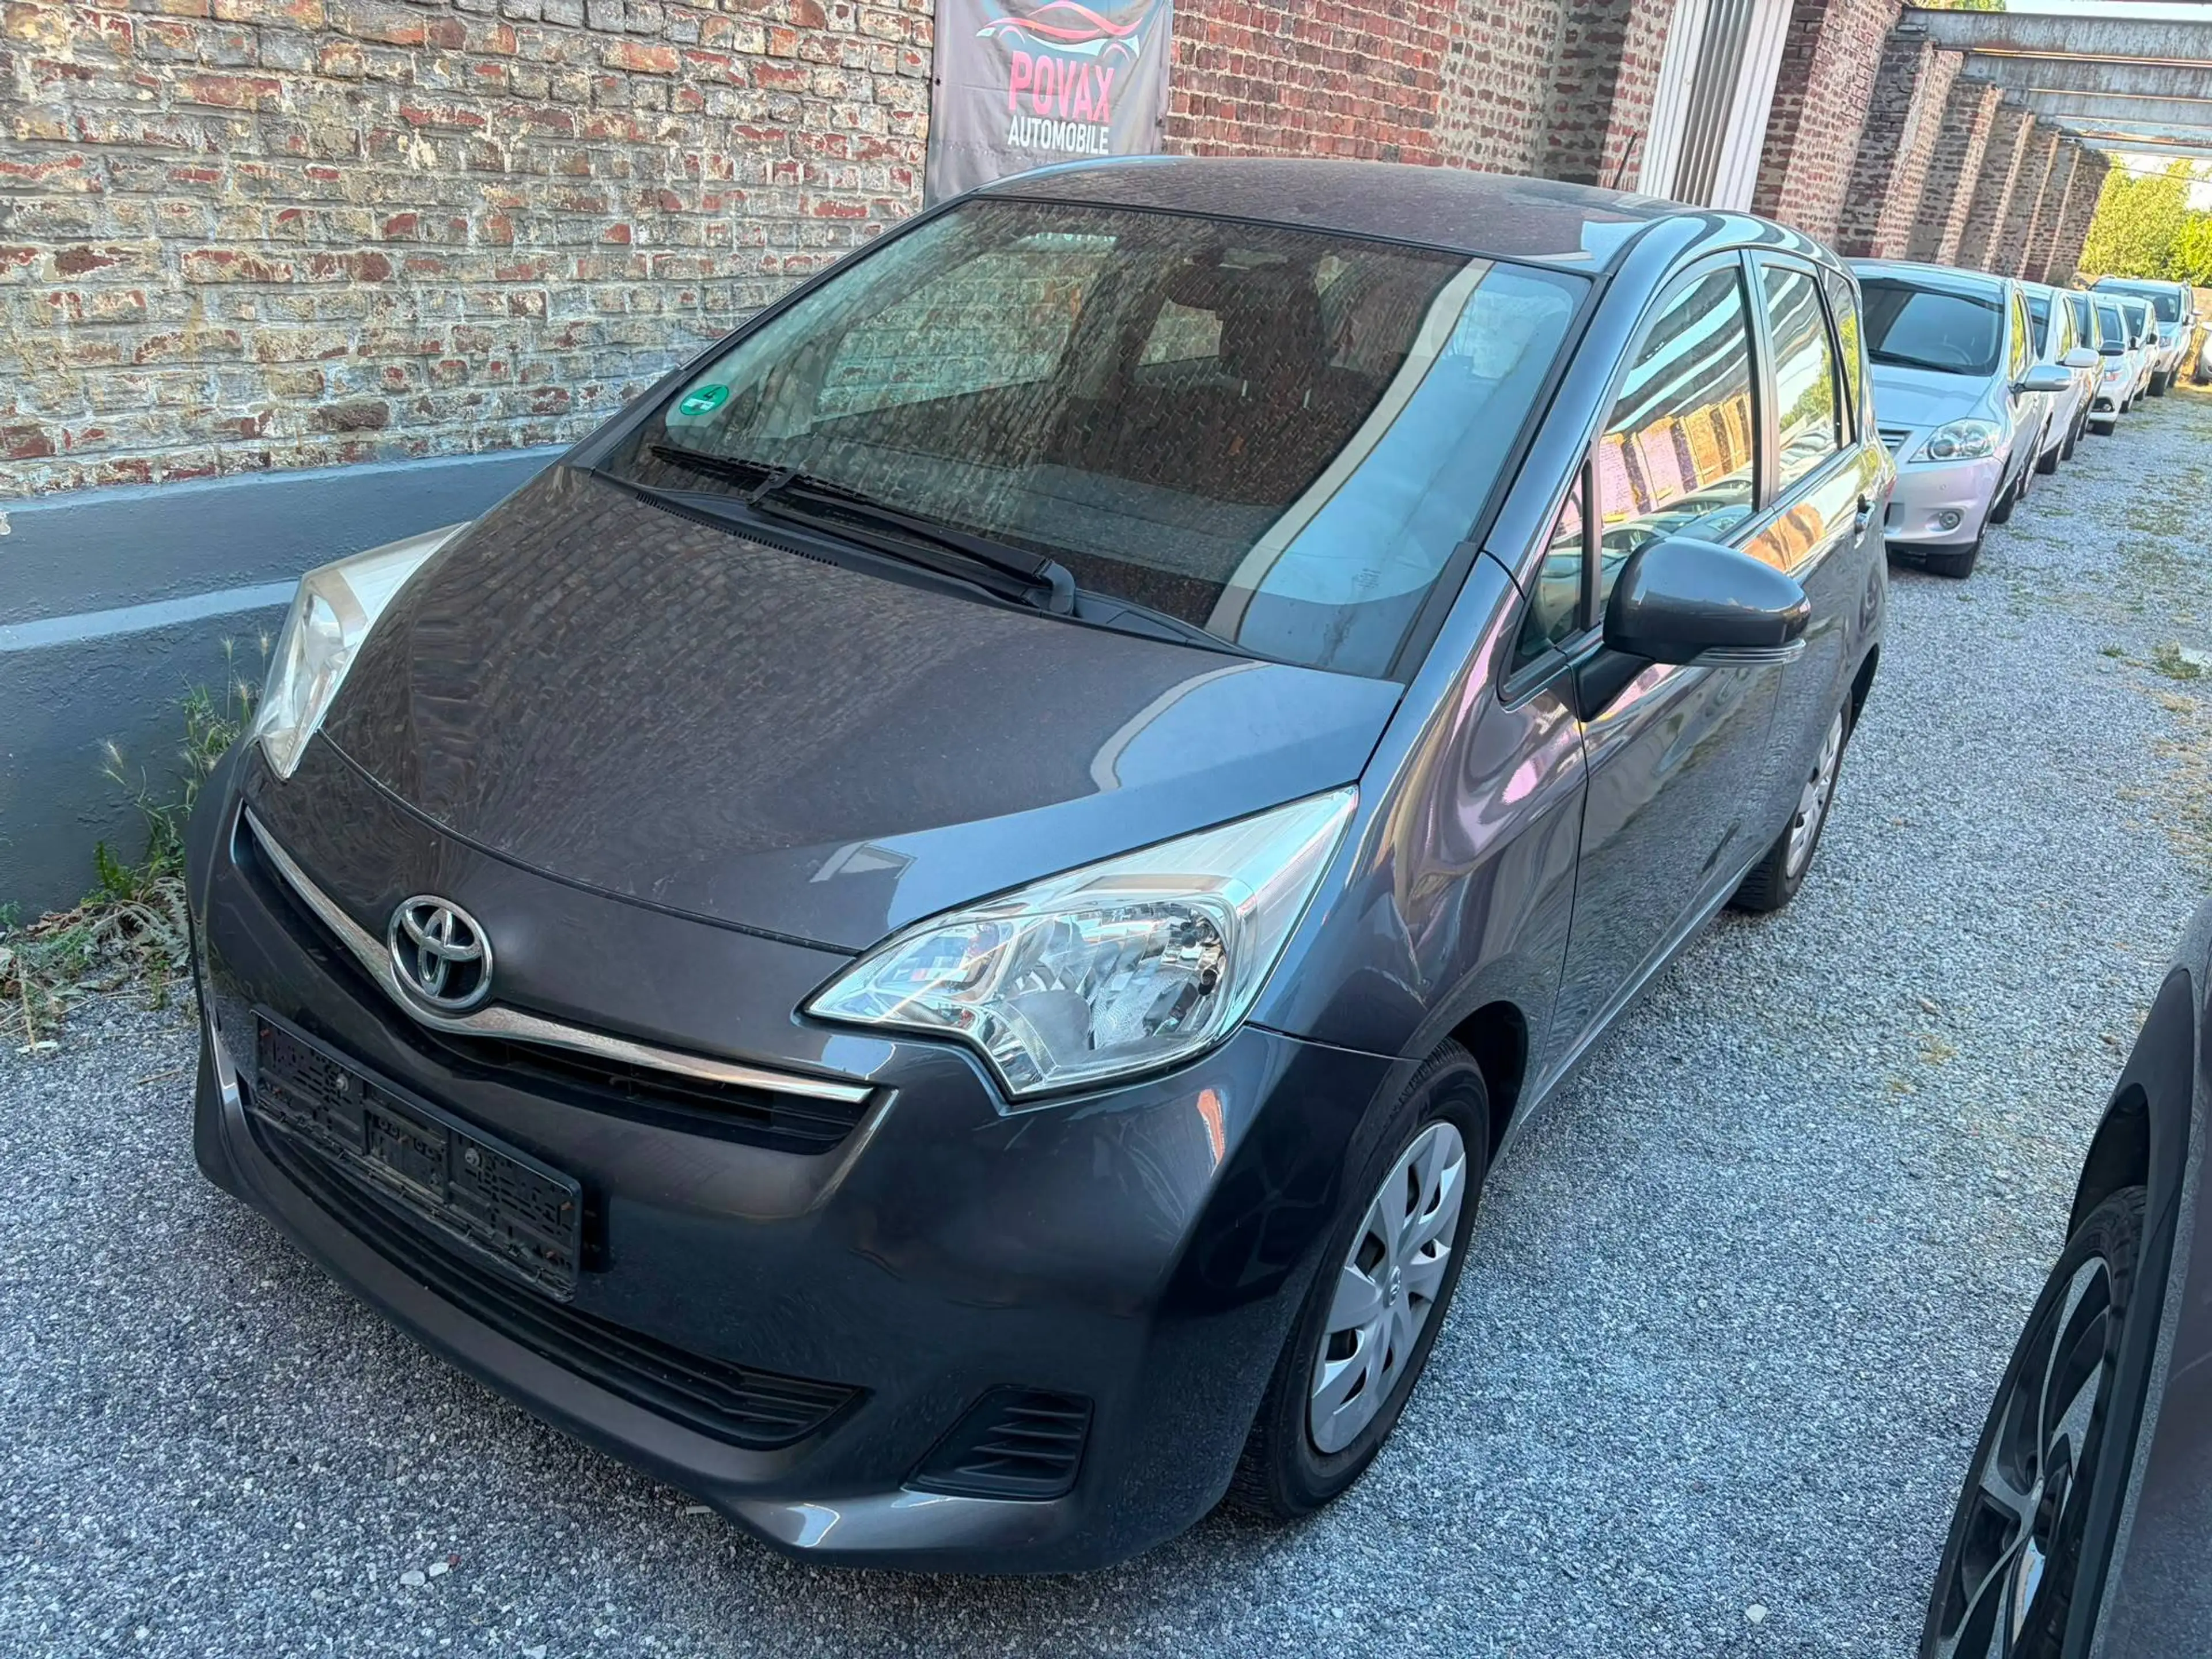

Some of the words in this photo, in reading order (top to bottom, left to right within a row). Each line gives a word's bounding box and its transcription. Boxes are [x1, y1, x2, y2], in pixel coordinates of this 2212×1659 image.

[1009, 51, 1115, 123] POVAX
[1007, 116, 1109, 154] AUTOMOBILE
[703, 387, 722, 400] 4
